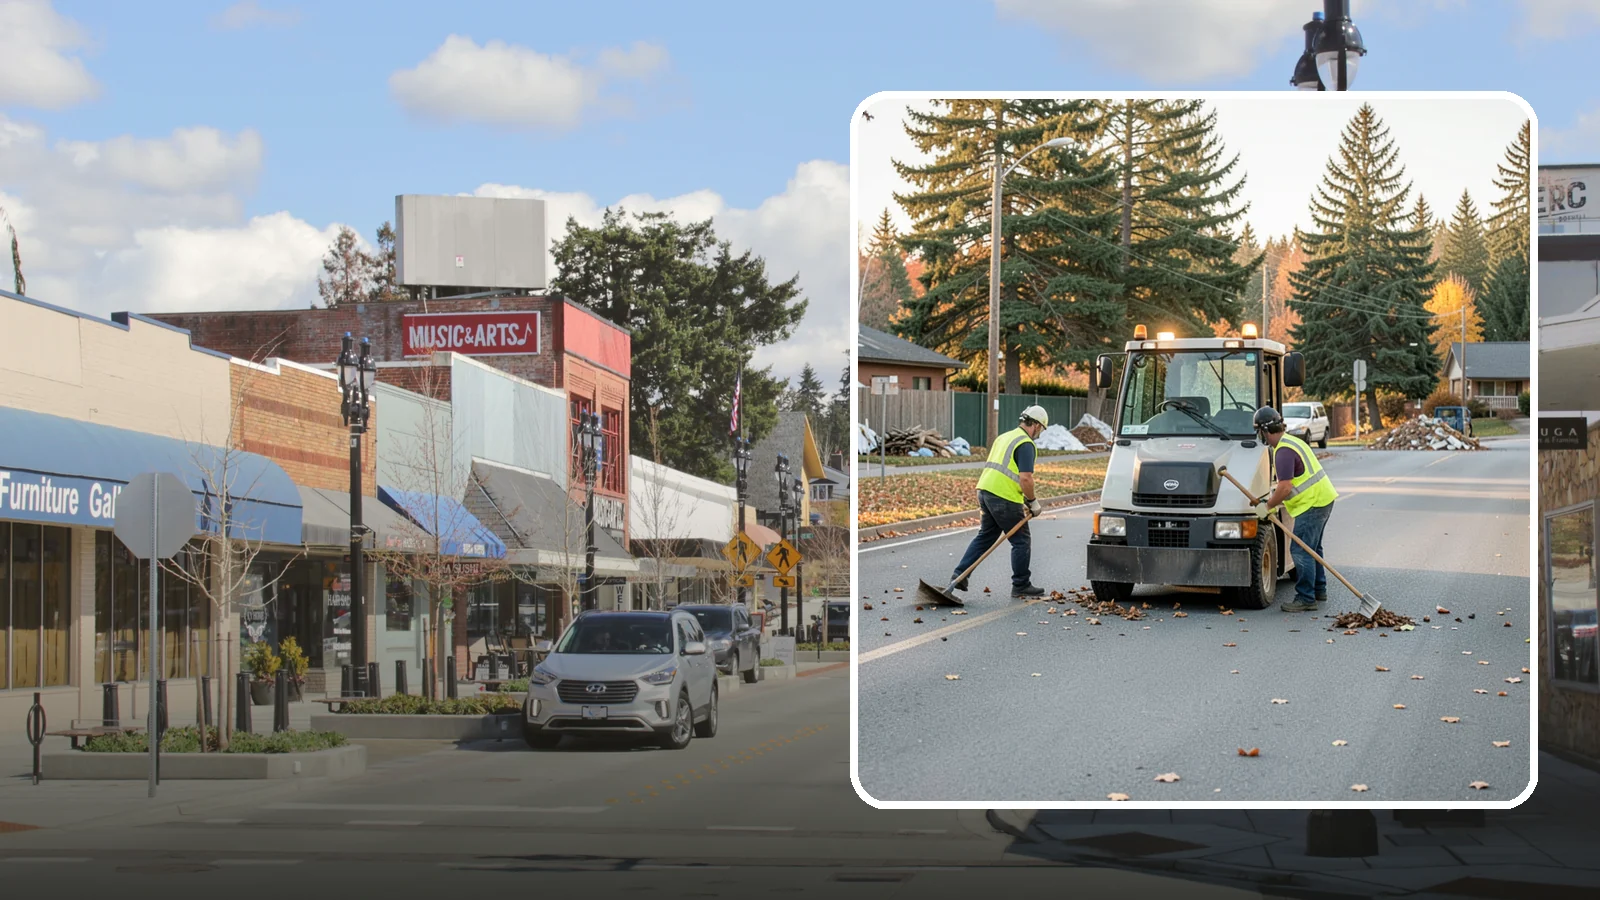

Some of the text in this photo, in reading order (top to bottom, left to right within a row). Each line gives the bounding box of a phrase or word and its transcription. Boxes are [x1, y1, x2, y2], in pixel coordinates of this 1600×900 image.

[409, 323, 520, 350] MUSIC&ARTS
[1540, 427, 1578, 437] UGA
[0, 471, 122, 519] Furniture Gal
